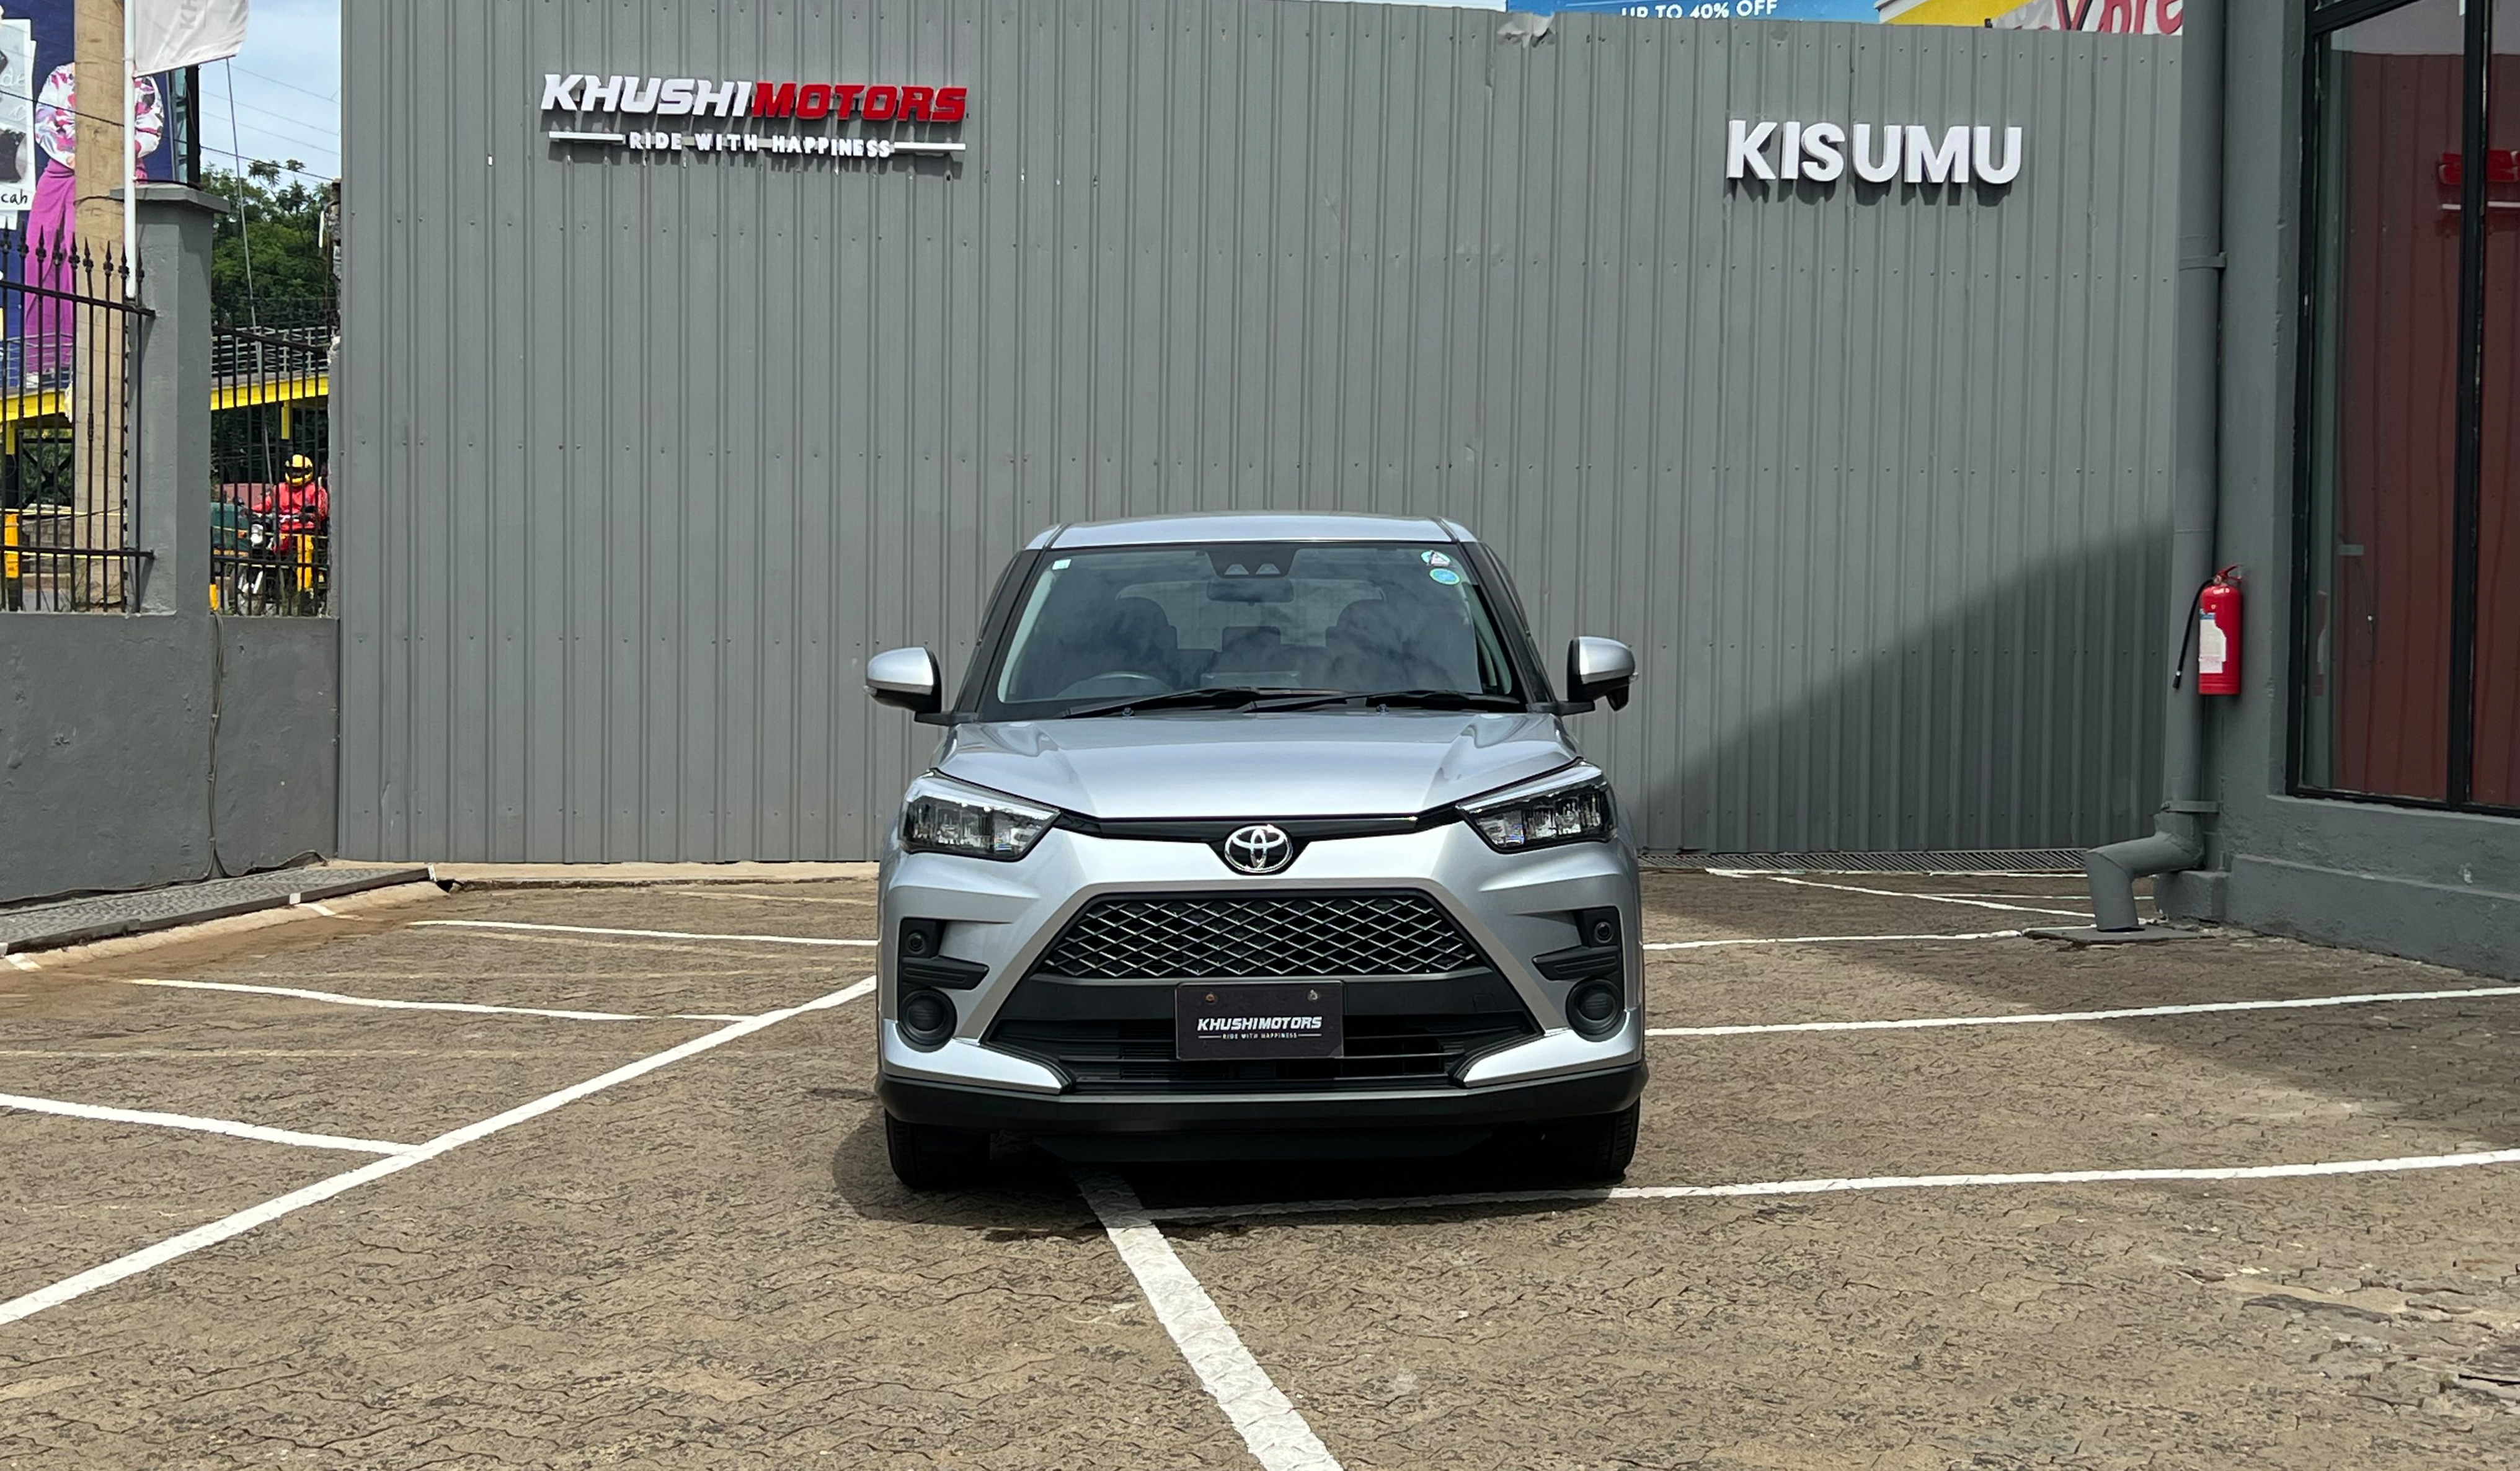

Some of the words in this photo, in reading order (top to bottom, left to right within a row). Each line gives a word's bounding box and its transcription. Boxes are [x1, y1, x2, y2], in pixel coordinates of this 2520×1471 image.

[1655, 5, 1682, 18] TO
[1690, 2, 1729, 19] 40%
[1736, 0, 1778, 16] OFF
[629, 131, 682, 150] RIDE
[694, 133, 758, 152] WITH
[771, 134, 890, 158] HAPPINESS
[1726, 119, 2023, 185] KISUMU
